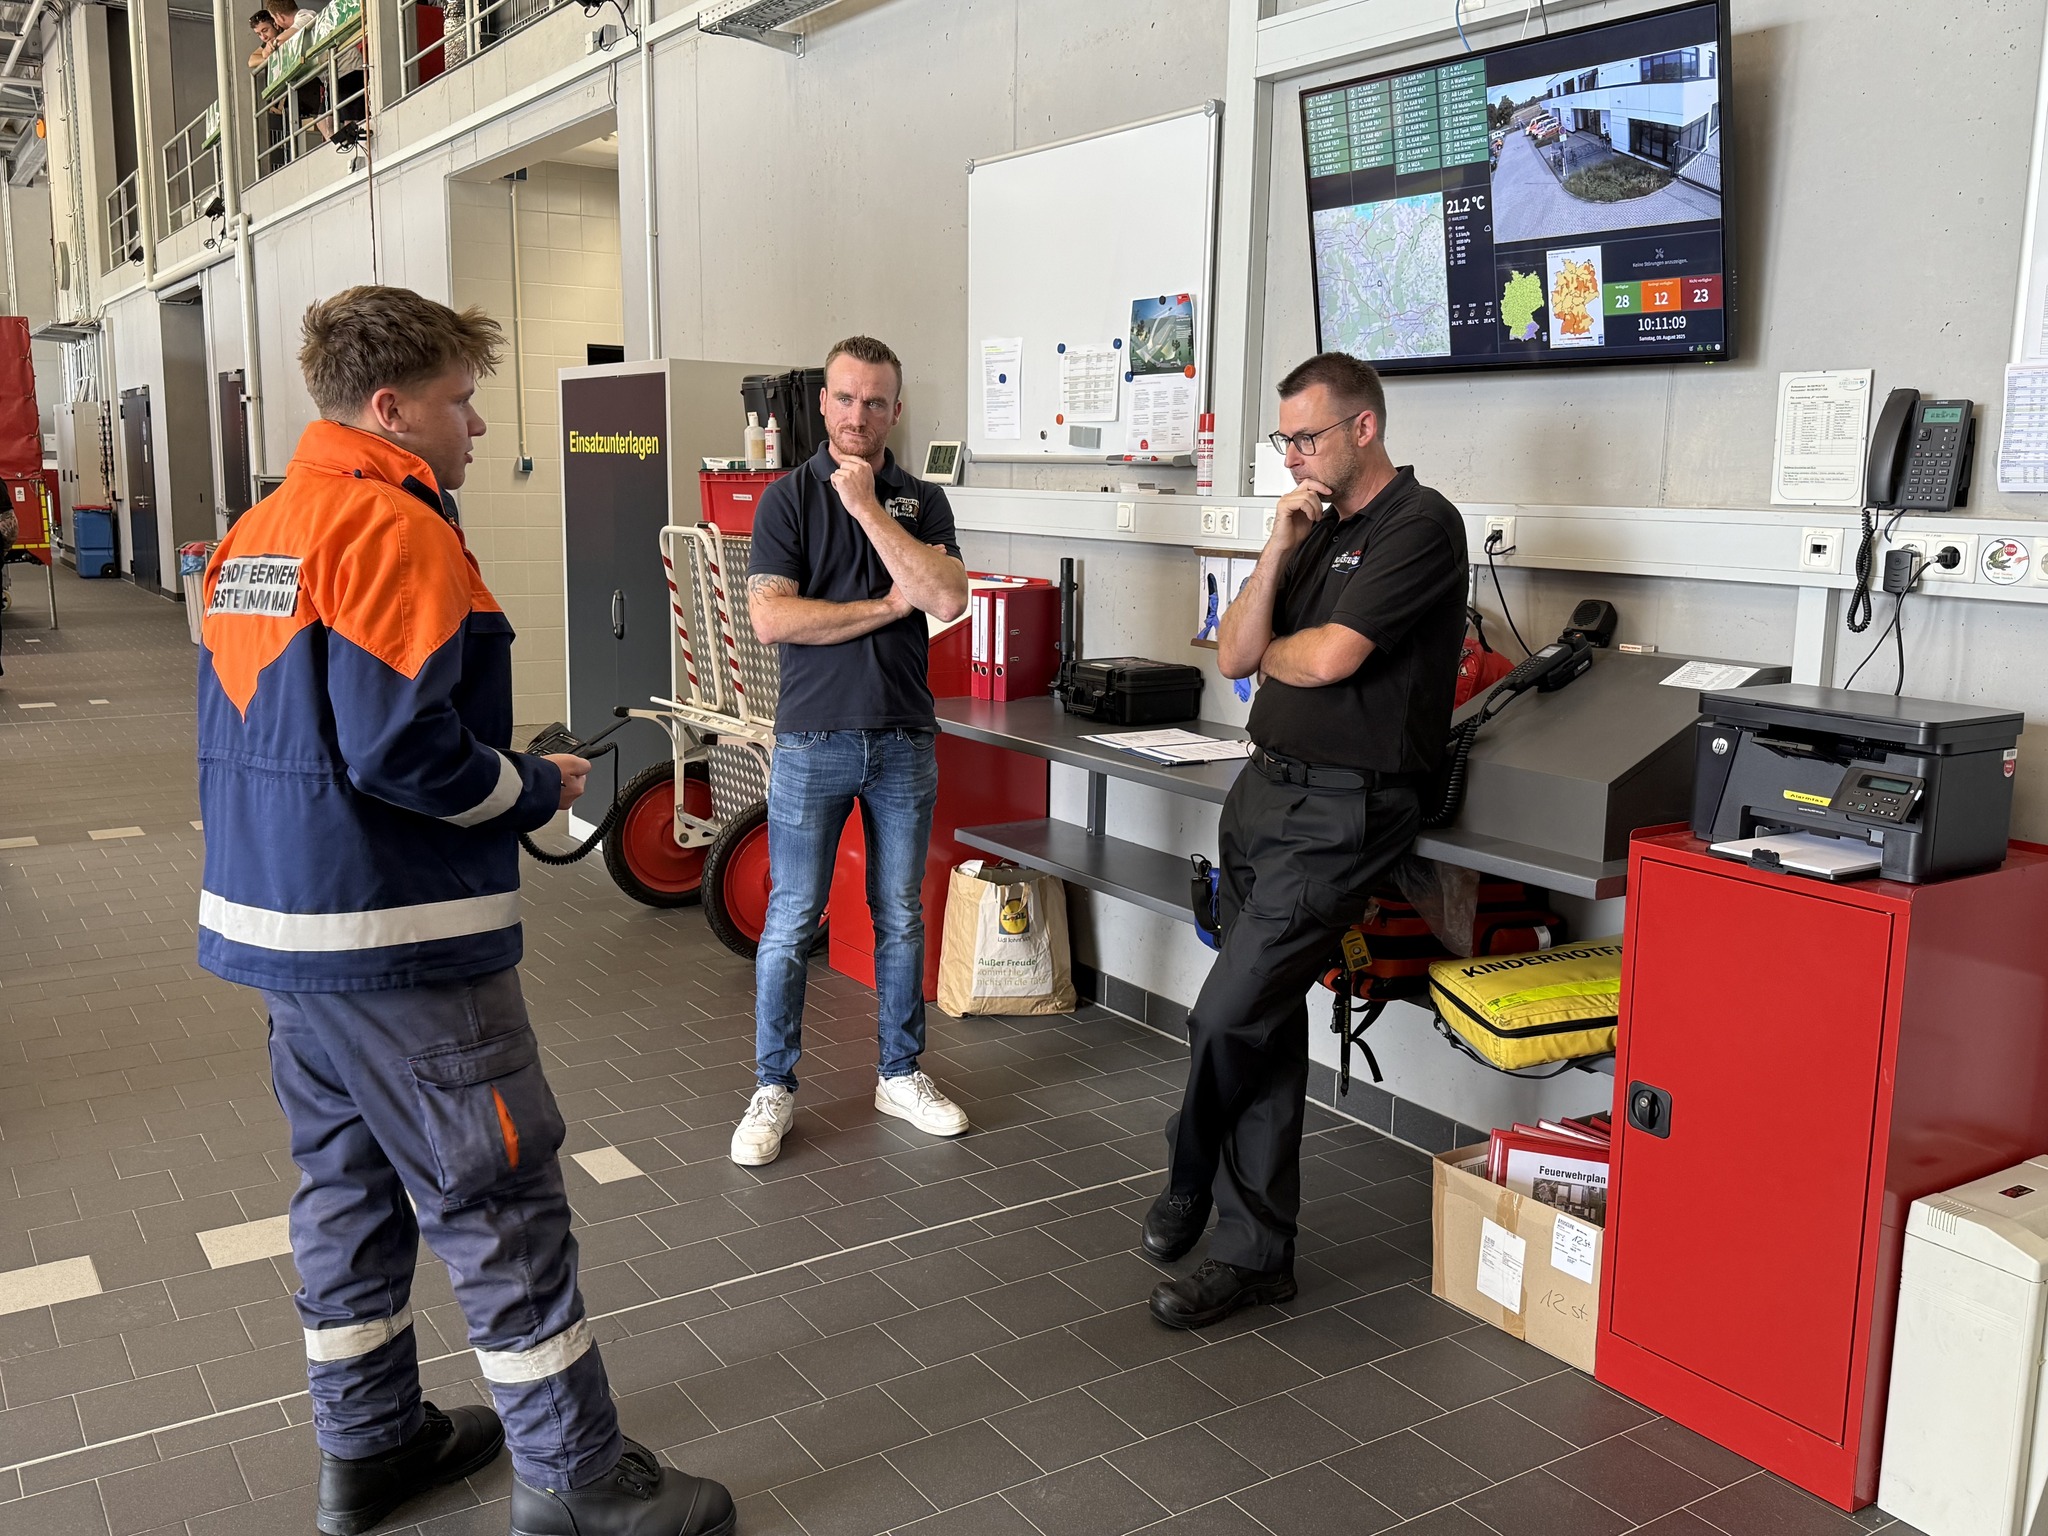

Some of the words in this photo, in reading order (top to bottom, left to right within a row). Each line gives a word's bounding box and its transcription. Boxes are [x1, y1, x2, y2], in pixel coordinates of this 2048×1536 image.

[1446, 198, 1470, 214] 21.2
[1615, 295, 1630, 308] 28
[1654, 292, 1668, 305] 12
[1694, 289, 1709, 302] 23
[1638, 316, 1686, 331] 10:11:09
[569, 430, 659, 460] Einsatzunterlagen
[1714, 737, 1726, 754] hp
[1790, 794, 1823, 803] Alarmfax
[1002, 912, 1026, 921] LIDL
[978, 958, 1005, 967] Außer
[1539, 1165, 1606, 1185] Feuerwehrplan
[1572, 1235, 1583, 1245] 12
[1540, 1289, 1567, 1315] 12
